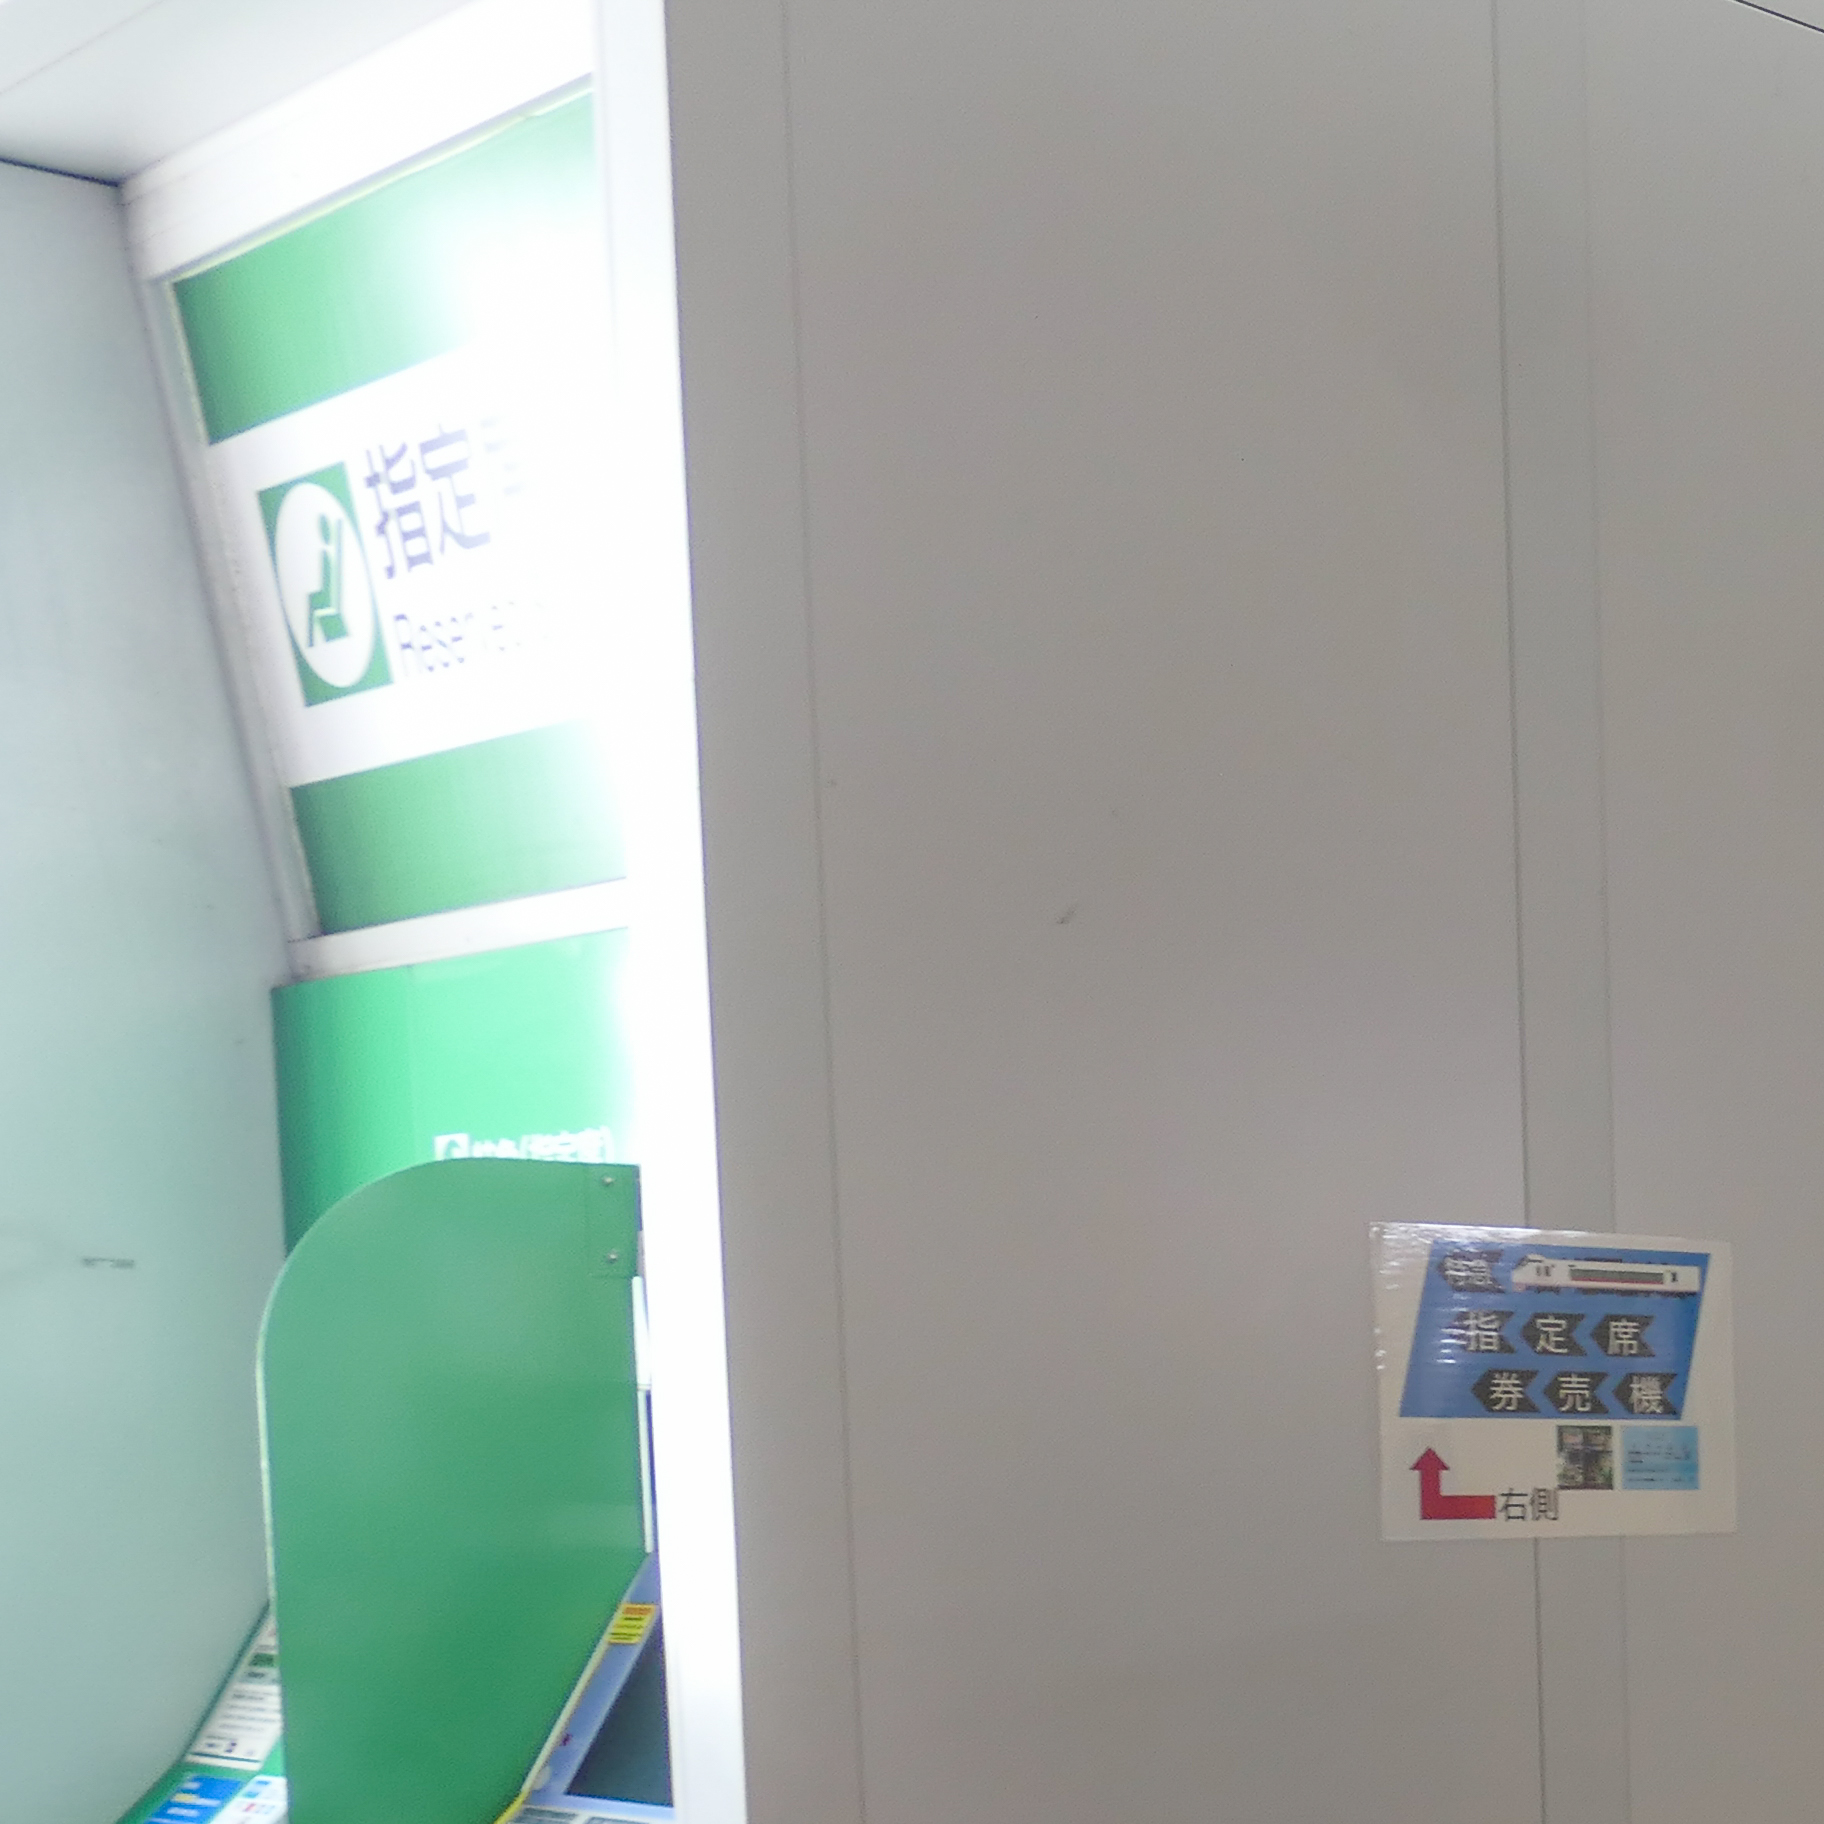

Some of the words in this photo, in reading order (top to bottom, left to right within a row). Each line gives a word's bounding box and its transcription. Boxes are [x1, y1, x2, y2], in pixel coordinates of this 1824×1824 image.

[364, 422, 505, 580] 指定
[1463, 1309, 1642, 1357] 指定席
[1488, 1373, 1667, 1415] 券売機
[1499, 1487, 1560, 1522] 右側
